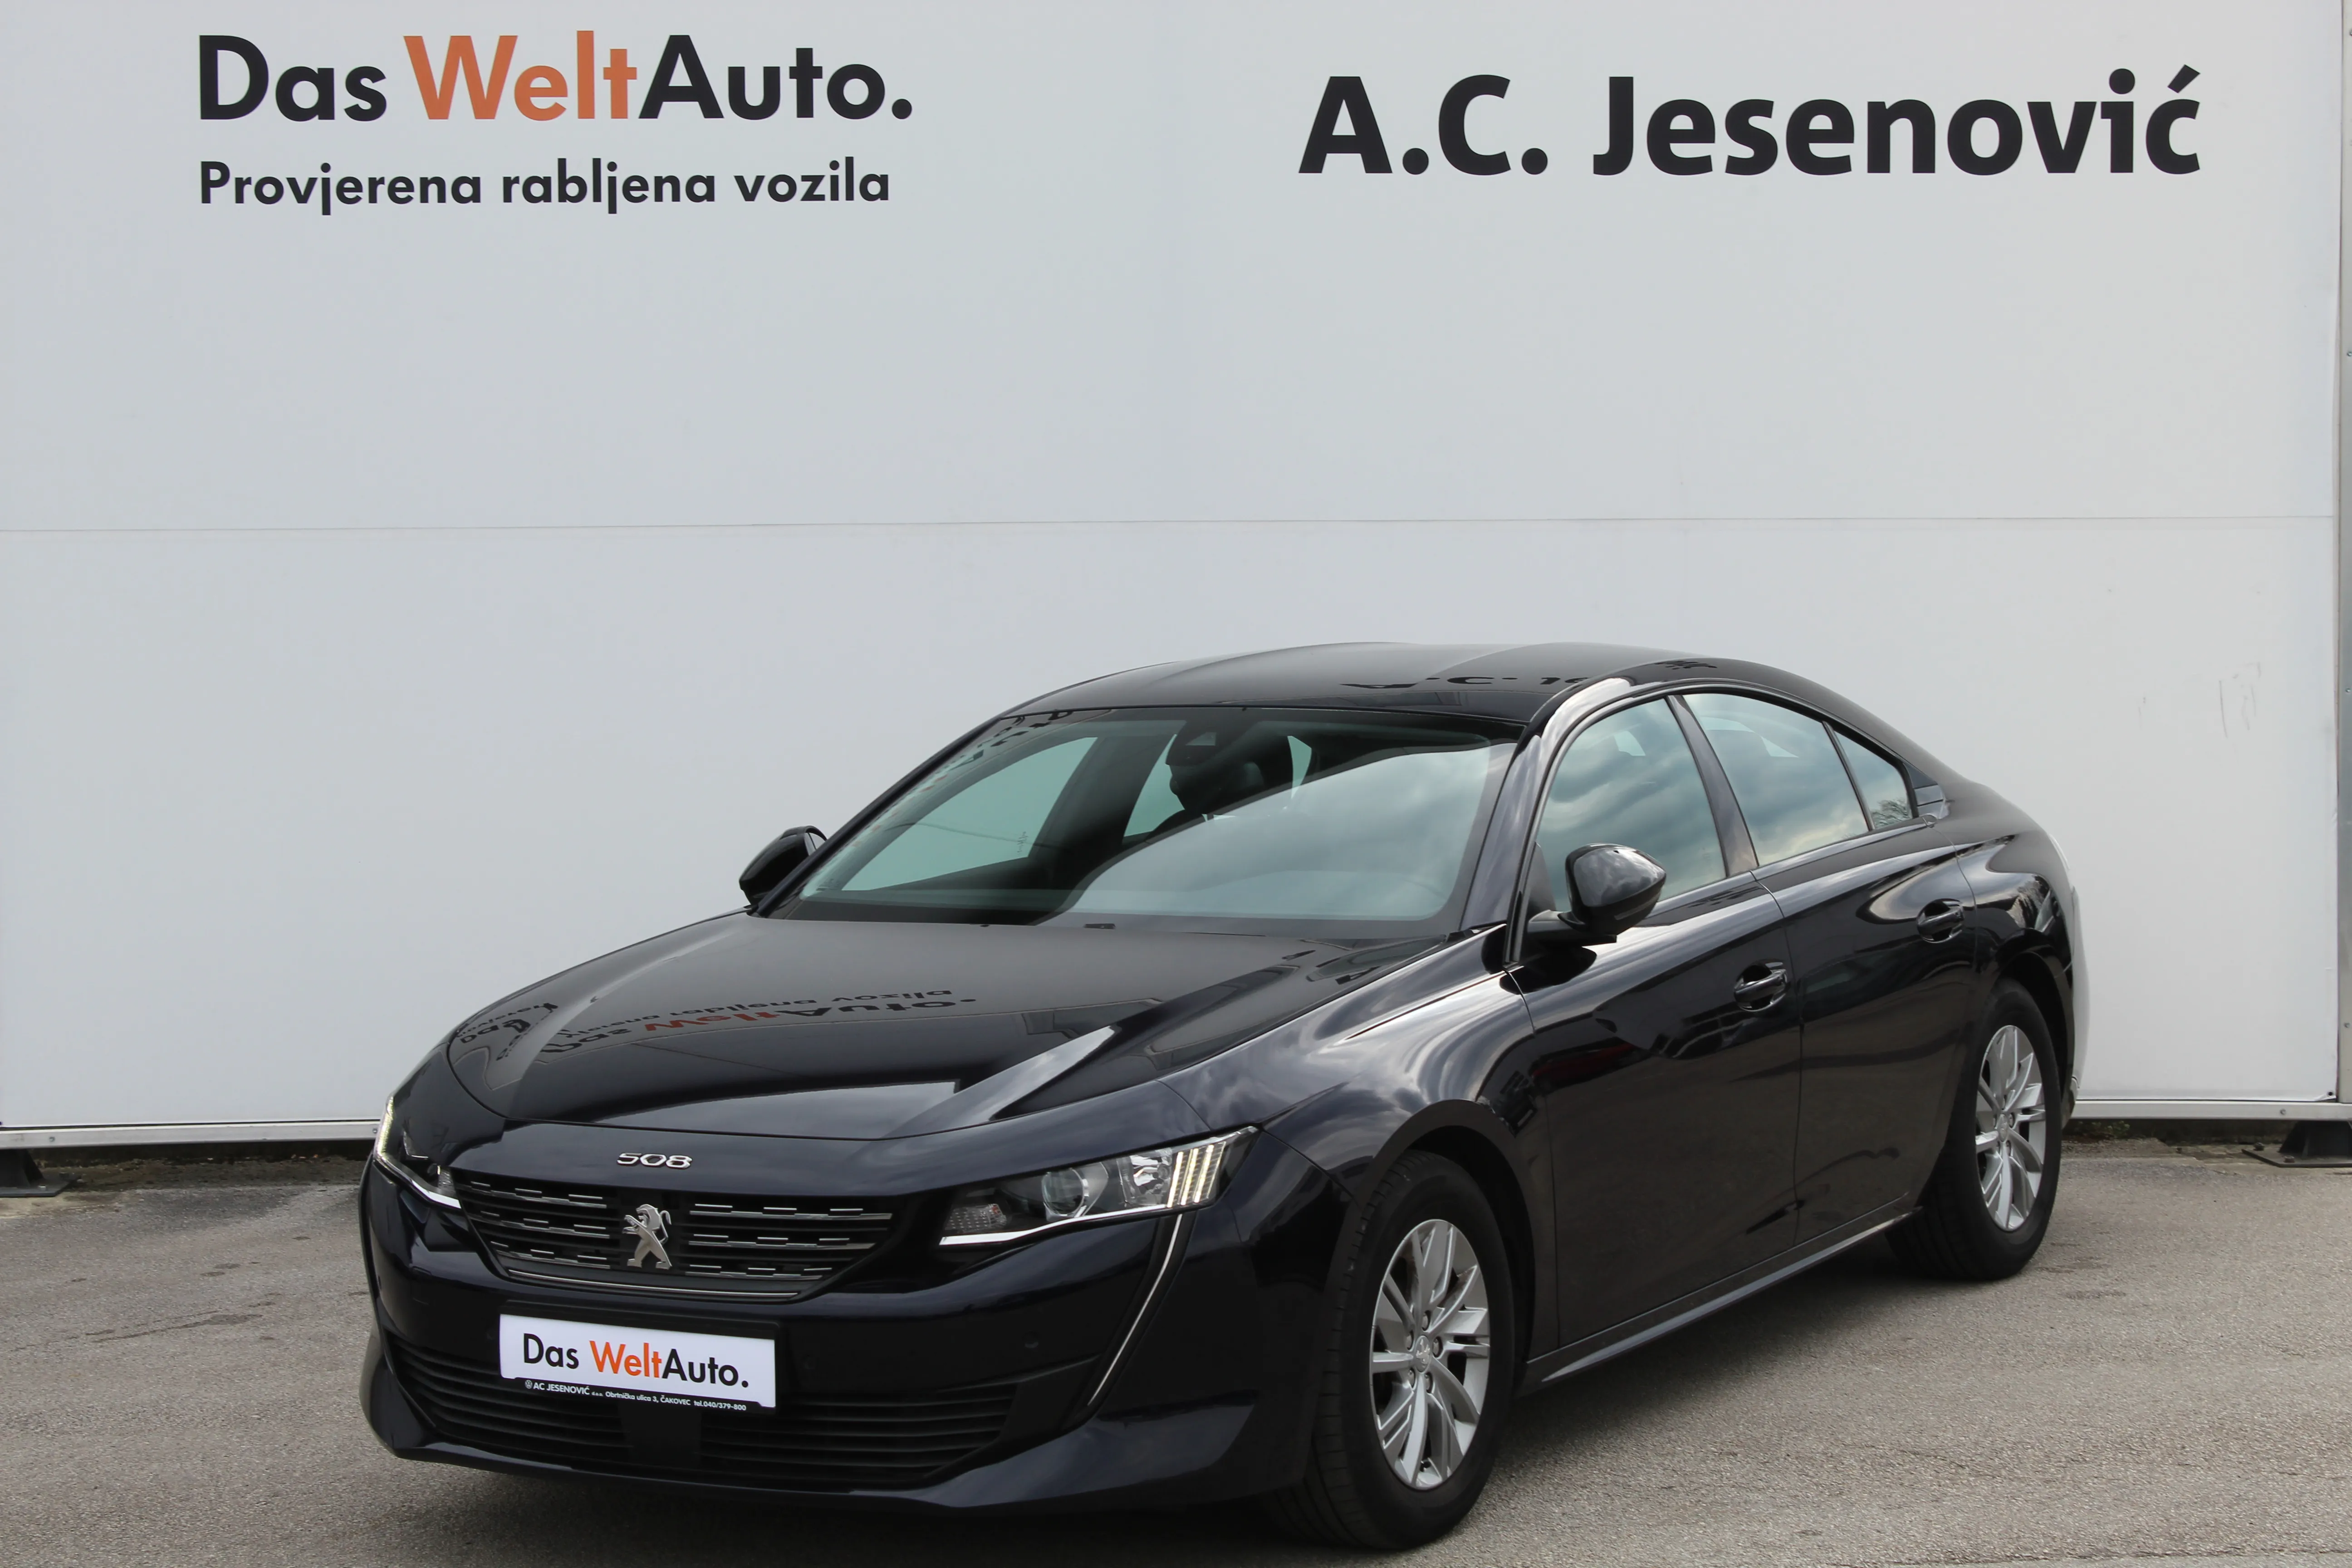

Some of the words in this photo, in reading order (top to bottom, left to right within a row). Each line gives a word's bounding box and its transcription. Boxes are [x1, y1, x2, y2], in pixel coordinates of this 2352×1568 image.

[199, 35, 387, 122] Das
[404, 30, 912, 122] WeltAuto.
[1298, 74, 1548, 176] A.C.
[1593, 64, 2200, 176] Jesenović
[201, 161, 481, 216] Provjerena
[503, 157, 715, 214] rabljena
[734, 156, 888, 204] vozila
[617, 1152, 693, 1169] 508
[523, 1333, 579, 1369] Das
[589, 1340, 749, 1388] WeltAuto.
[533, 1382, 545, 1390] AC
[546, 1384, 590, 1395] JESENOVIĆ
[660, 1395, 691, 1406] ČAKOVEC
